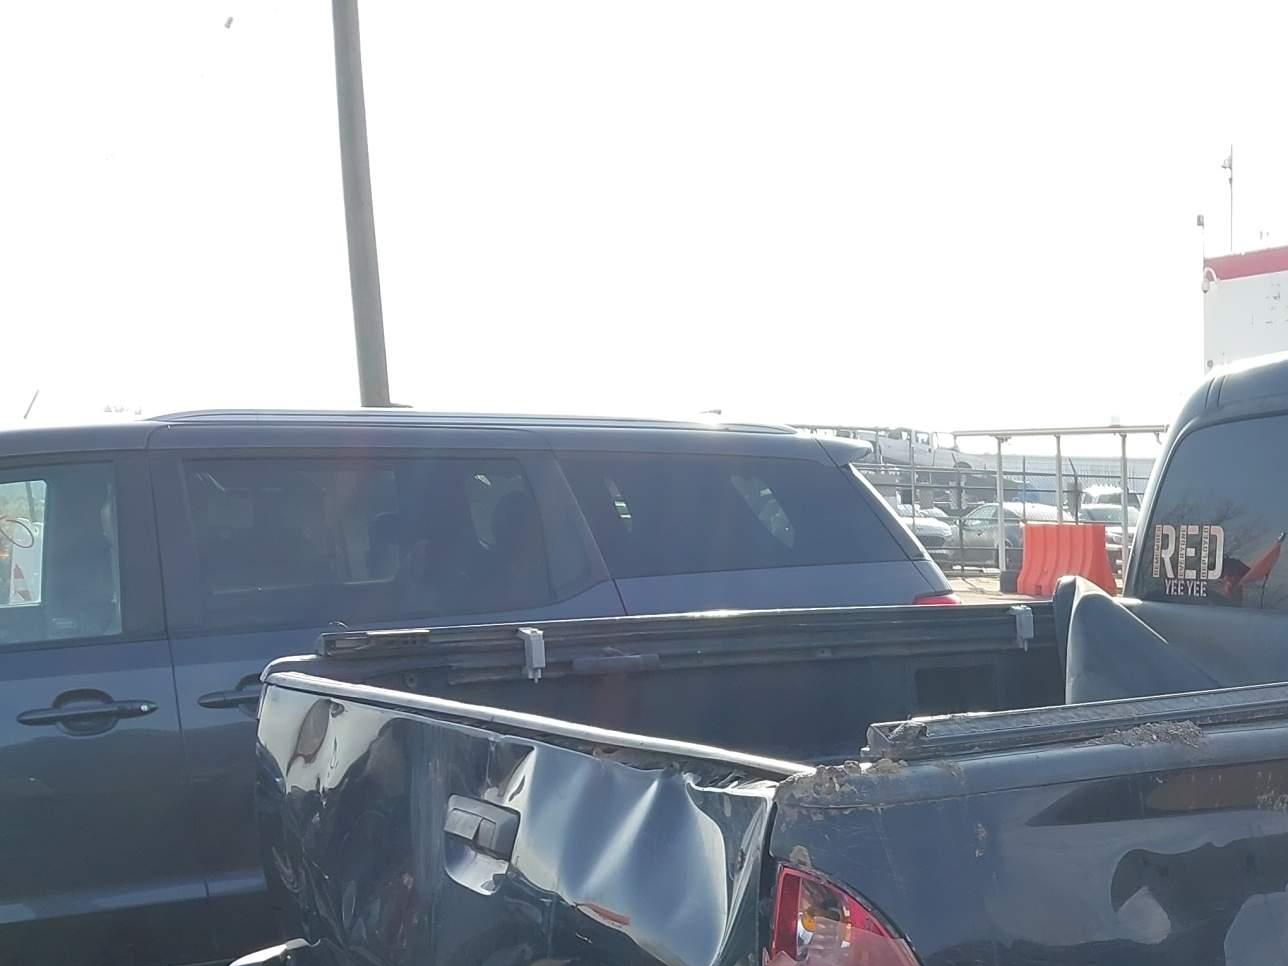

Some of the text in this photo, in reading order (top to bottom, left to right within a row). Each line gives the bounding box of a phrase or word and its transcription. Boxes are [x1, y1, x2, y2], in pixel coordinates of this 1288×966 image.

[1153, 525, 1224, 579] RED
[1165, 579, 1207, 597] YEE YEE
